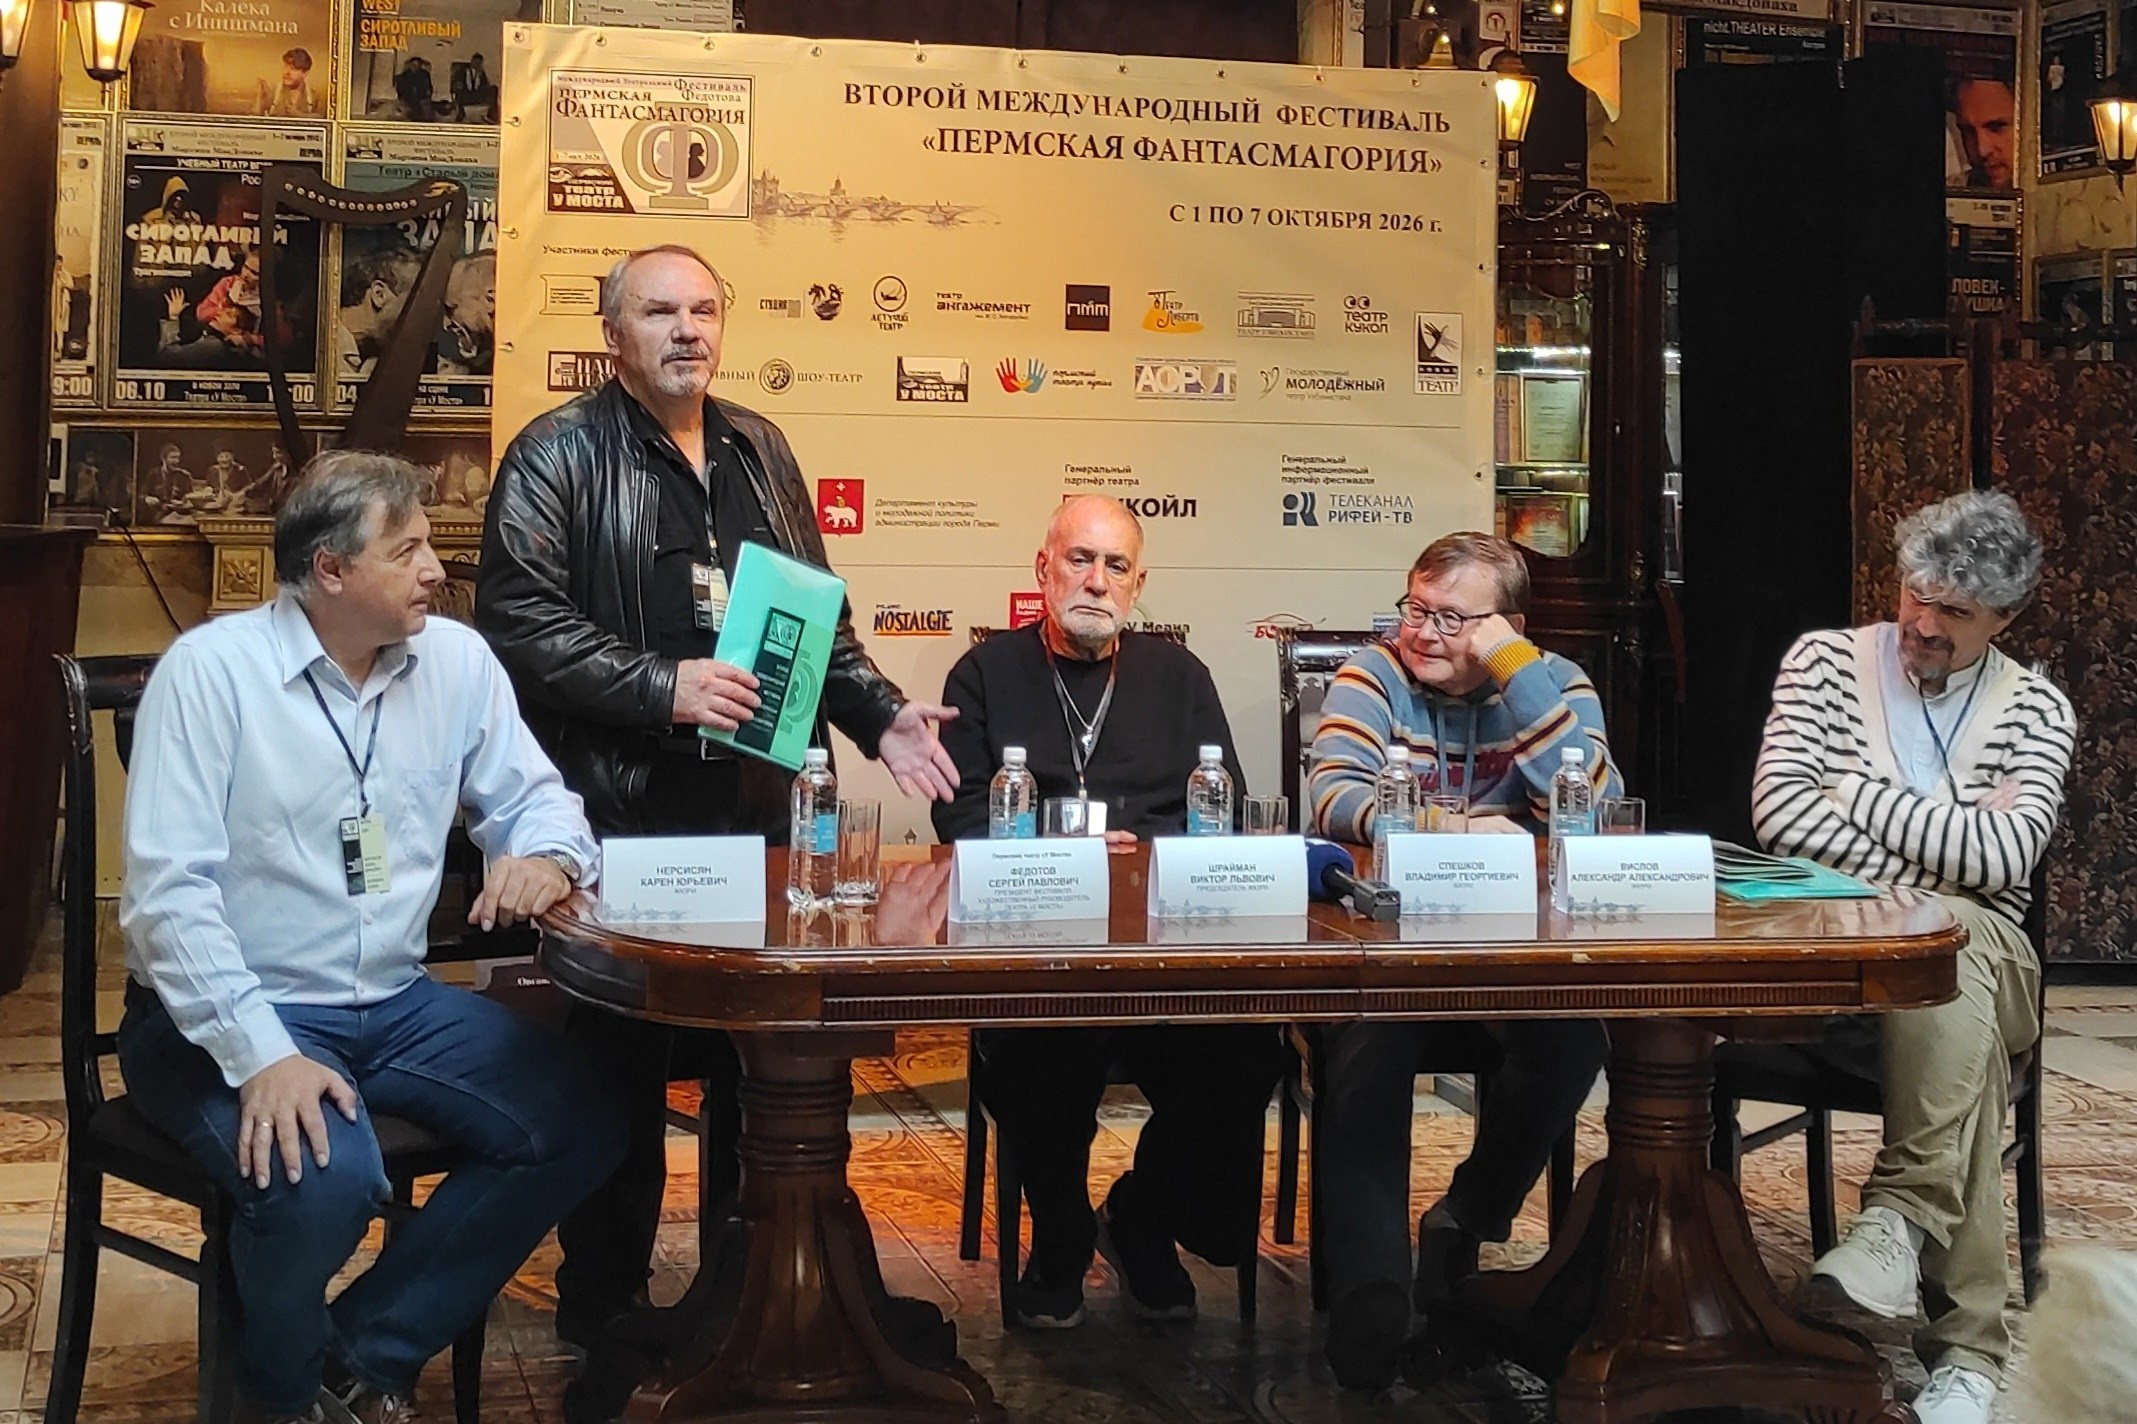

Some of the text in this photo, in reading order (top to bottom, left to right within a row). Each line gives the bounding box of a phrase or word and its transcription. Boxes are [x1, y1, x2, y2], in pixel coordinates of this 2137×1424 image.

[169, 12, 298, 34] с Инишмана
[360, 19, 462, 38] СИРОТЛИВЫЙ
[360, 34, 408, 51] ЗАПАД
[674, 78, 748, 93] Фестиваль
[559, 87, 742, 104] ПЕРМСКАЯ Федотова
[556, 97, 746, 124] ФАНТАСМАГОРИЯ
[844, 82, 1450, 133] ВТОРОЙ МЕЖДУНАРОДНЫЙ ФЕСТИВАЛЬ
[923, 127, 1442, 174] «ПЕРМСКАЯ ФАНТАСМАГОРИЯ»
[566, 194, 624, 208] МОСТА
[1169, 204, 1443, 233] С 1 ПО 7 ОКТЯБРЯ 2026 г.
[543, 245, 599, 255] Участники
[140, 245, 235, 271] ЗАПАД
[1951, 278, 2007, 296] ЛОВЕК-
[936, 301, 1032, 314] ангажемент
[715, 370, 863, 383] ВНЫЙ ШОУ-ТЕАТР
[116, 382, 165, 400] 06.10
[1286, 377, 1385, 393] МОЛОДЁЖНЫЙ
[1418, 380, 1459, 392] ТЕАТР
[266, 385, 315, 403] 1:00
[912, 389, 965, 401] МОСТА
[1281, 454, 1347, 465] Генеральный
[1064, 463, 1132, 475] Генеральный
[1281, 466, 1370, 475] информационный
[1107, 478, 1140, 488] театра
[1322, 477, 1376, 486] фестиваля
[1120, 494, 1197, 517] КОЙЛ
[1329, 494, 1414, 509] ТЕЛЕКАНАЛ
[873, 610, 954, 633] NOSTALGIE
[656, 866, 712, 875] НЕРСИСЯН
[1010, 866, 1057, 876] ФЕДОТОВ
[1208, 863, 1257, 873] ШРАЙМАН
[1438, 862, 1486, 871] СПЕШКОВ
[1620, 863, 1660, 872] ВИСЛОВ
[640, 877, 728, 887] КАРЕН ЮРЬЕВИЧ
[988, 877, 1079, 888] СЕРГЕЙ ПАВЛОВИЧ
[1190, 875, 1275, 885] ВИКТОР ЛЬВОВИЧ
[1405, 873, 1520, 882] ВЛАДИМИР ГЕОРГИЕВИЧ
[1570, 873, 1710, 882] АЛЕКСАНДР АЛЕКСАНДРОВИЧ
